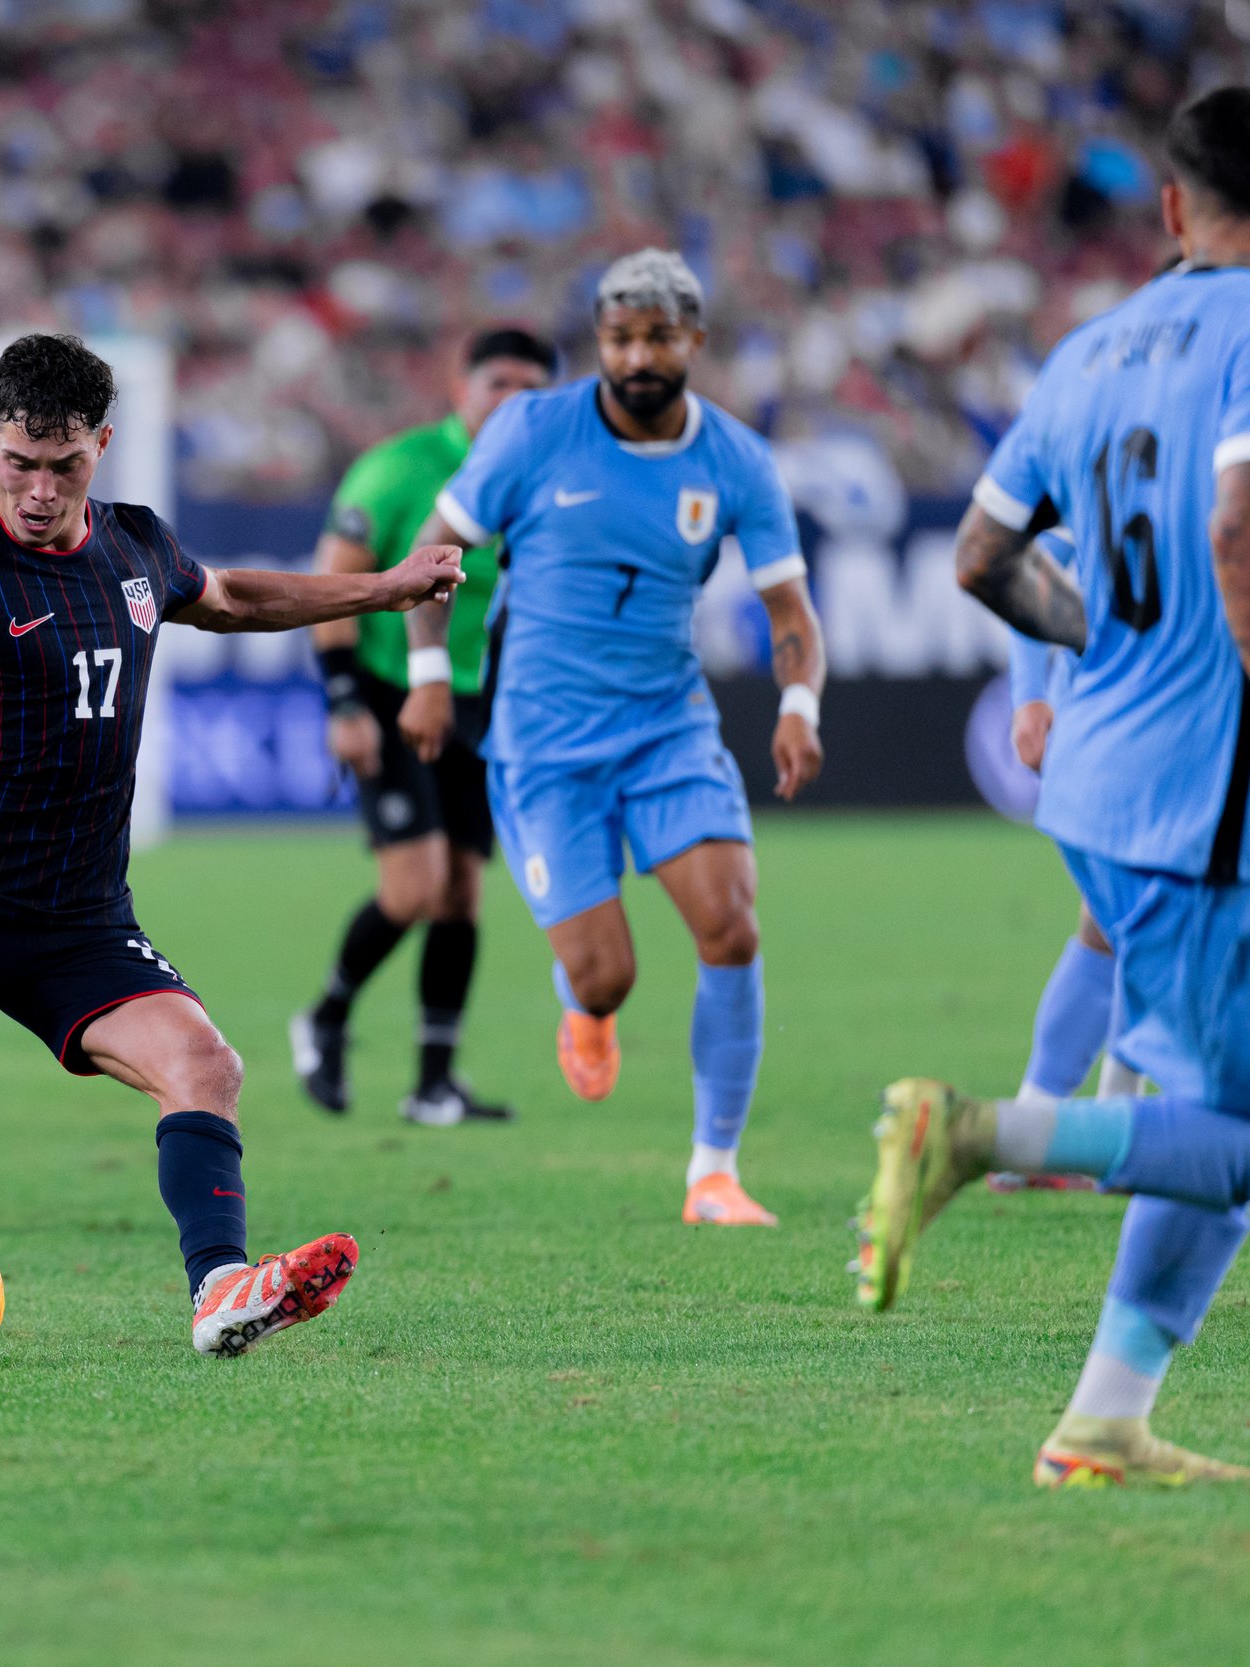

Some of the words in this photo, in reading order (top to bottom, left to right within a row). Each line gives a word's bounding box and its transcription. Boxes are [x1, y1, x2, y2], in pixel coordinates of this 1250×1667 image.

[1093, 426, 1162, 634] 16
[124, 580, 150, 600] USA
[614, 563, 639, 619] 7
[72, 648, 122, 719] 17
